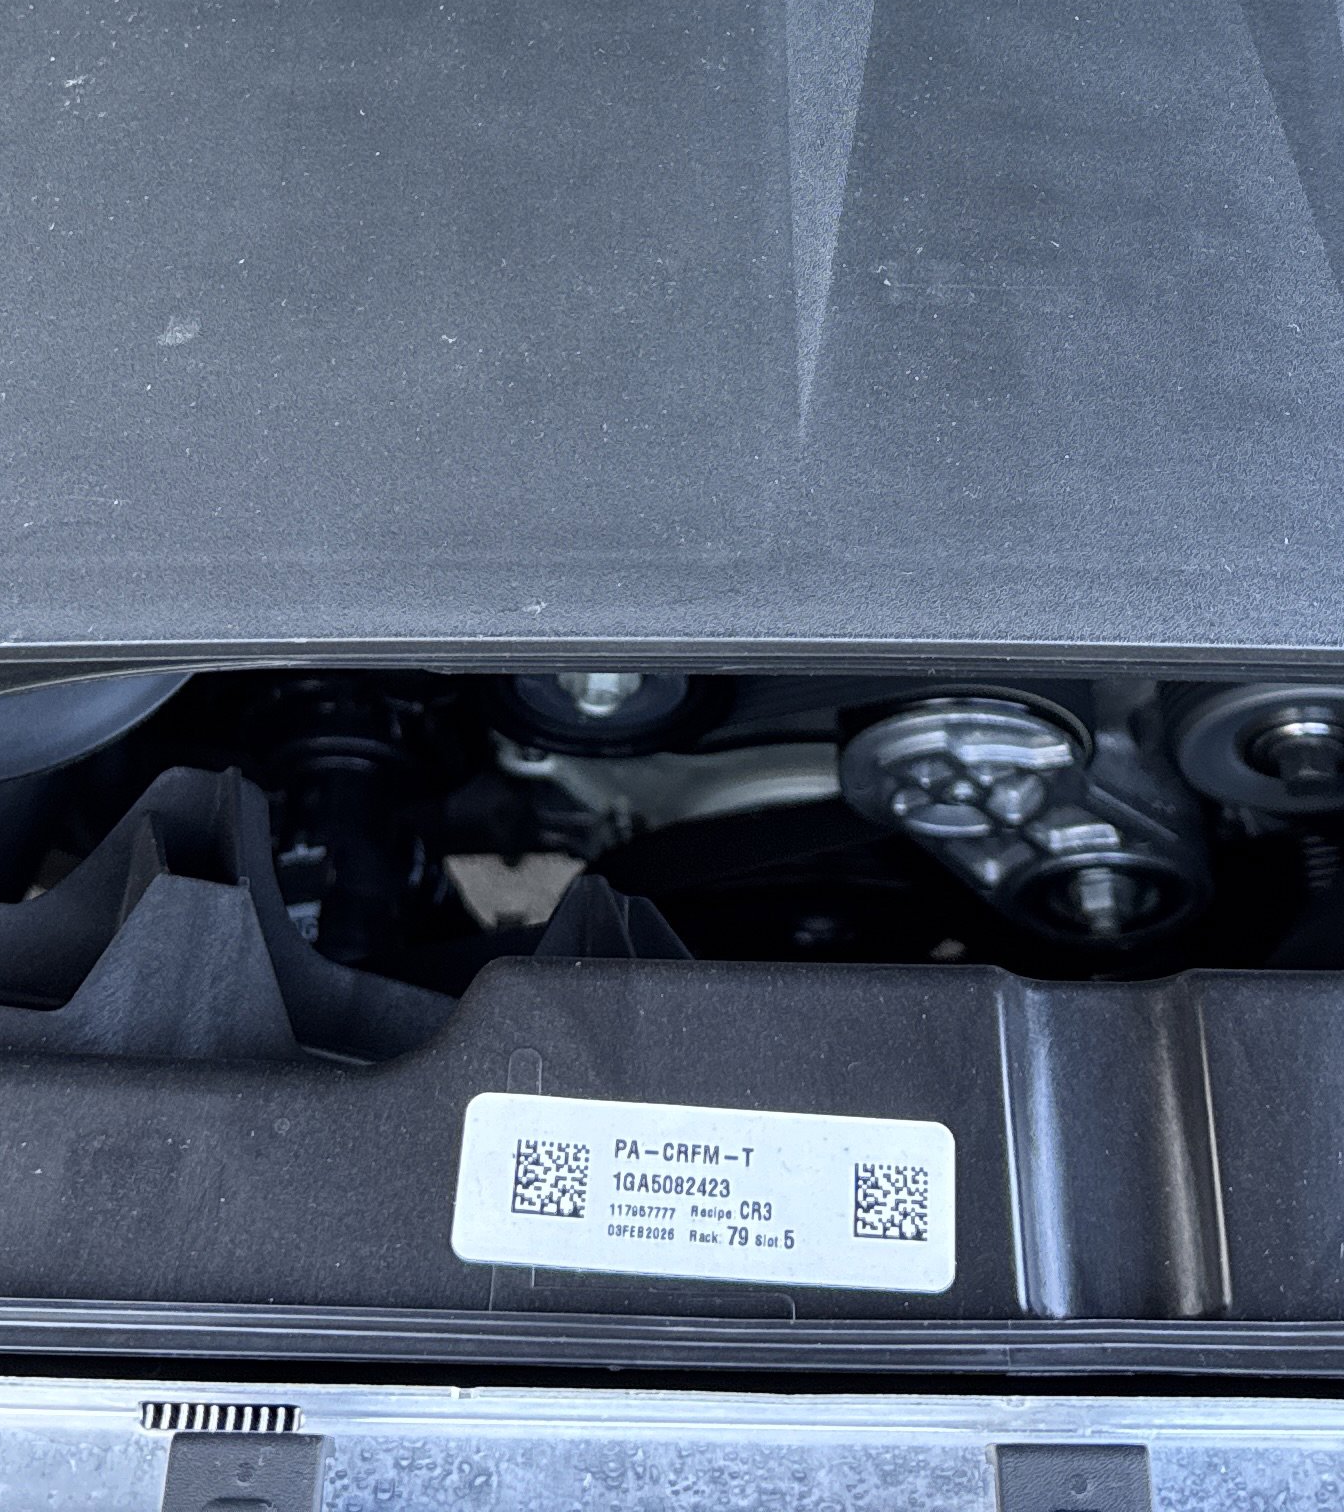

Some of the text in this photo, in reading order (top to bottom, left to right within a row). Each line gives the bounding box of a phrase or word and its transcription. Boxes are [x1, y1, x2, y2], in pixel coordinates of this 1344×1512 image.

[614, 1139, 755, 1168] PA-CRFM-T
[613, 1171, 731, 1198] 1GA5082423
[740, 1200, 772, 1221] CR3
[608, 1224, 675, 1241] 03FEB2026
[726, 1225, 749, 1246] 79
